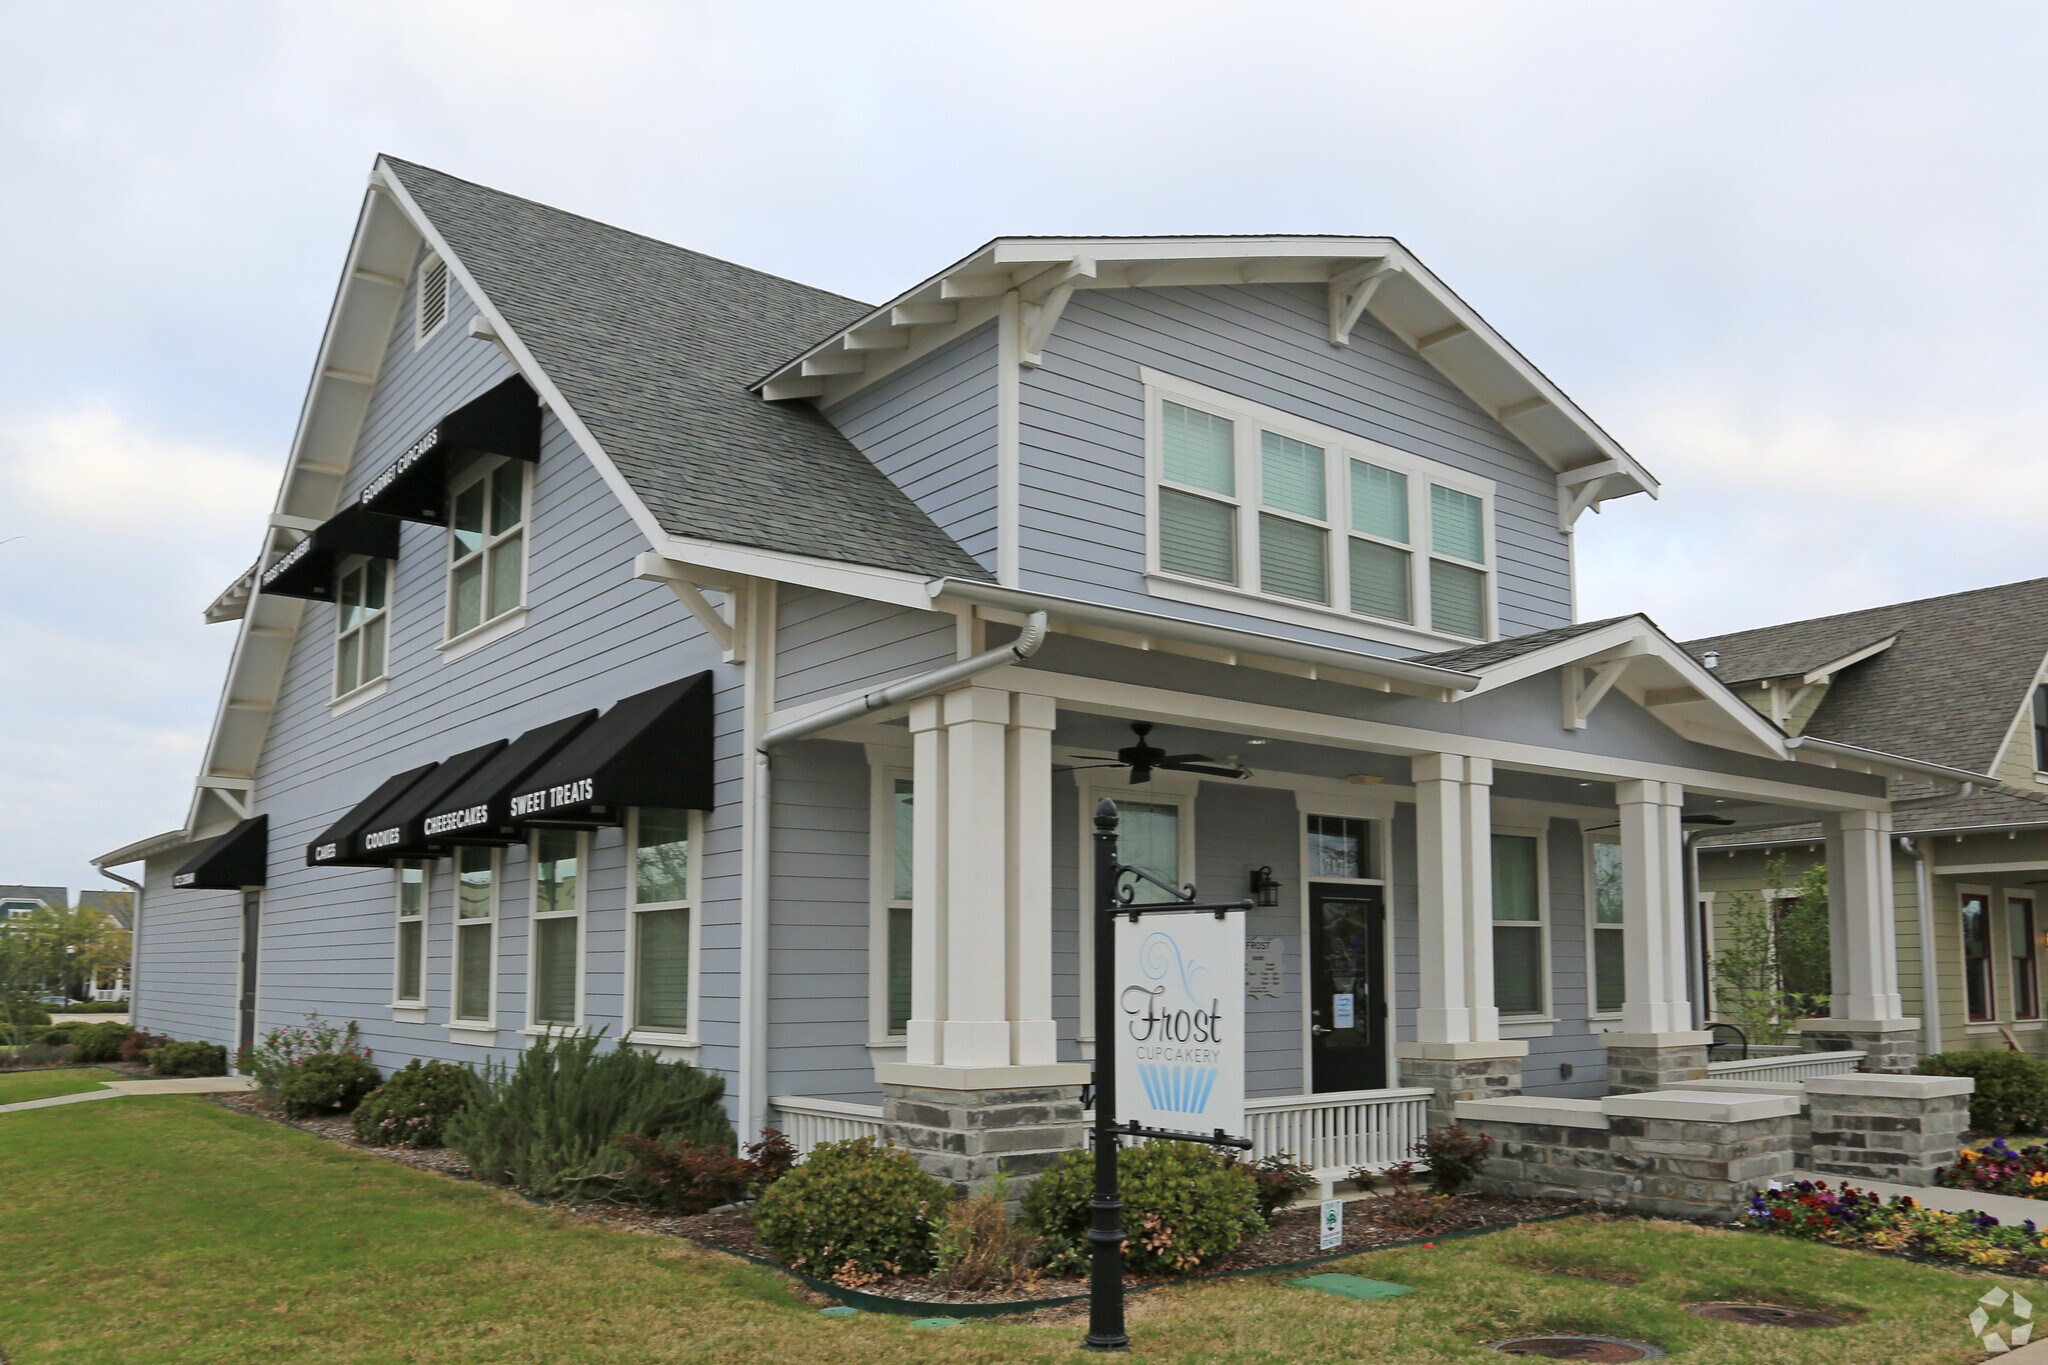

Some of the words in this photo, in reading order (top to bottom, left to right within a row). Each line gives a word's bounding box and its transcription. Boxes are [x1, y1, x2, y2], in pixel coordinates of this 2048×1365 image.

[362, 465, 396, 504] GOURMET
[397, 428, 438, 473] CUPCAKES
[510, 791, 546, 817] SWEET
[550, 778, 593, 808] TREATS
[423, 804, 488, 836] CHEESECAKES
[365, 827, 400, 850] COOKIES
[1120, 984, 1222, 1043] Frost
[1136, 1046, 1220, 1063] CUPCAKERY
